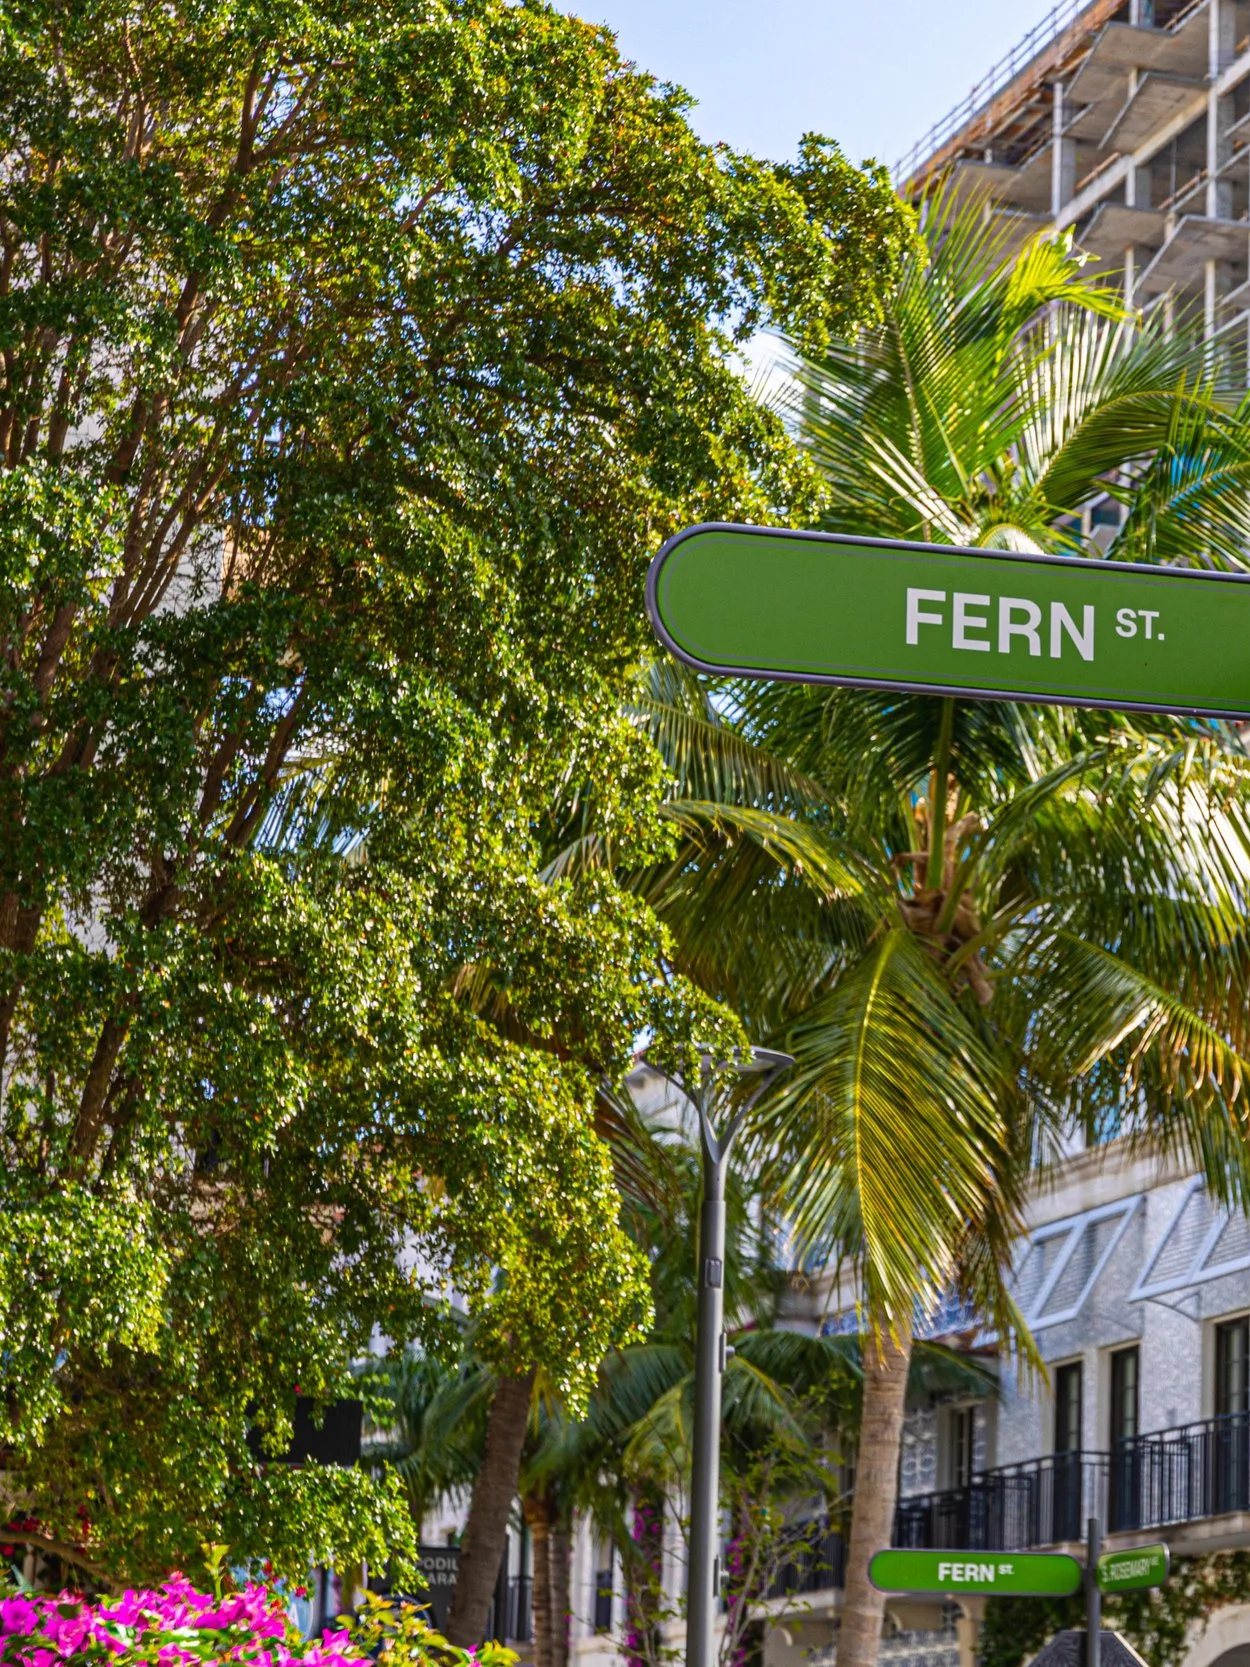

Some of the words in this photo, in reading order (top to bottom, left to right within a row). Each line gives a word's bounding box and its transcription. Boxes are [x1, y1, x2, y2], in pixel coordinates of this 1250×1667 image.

[906, 587, 1095, 662] FERN
[1115, 608, 1165, 640] ST.
[938, 1562, 995, 1582] FERN
